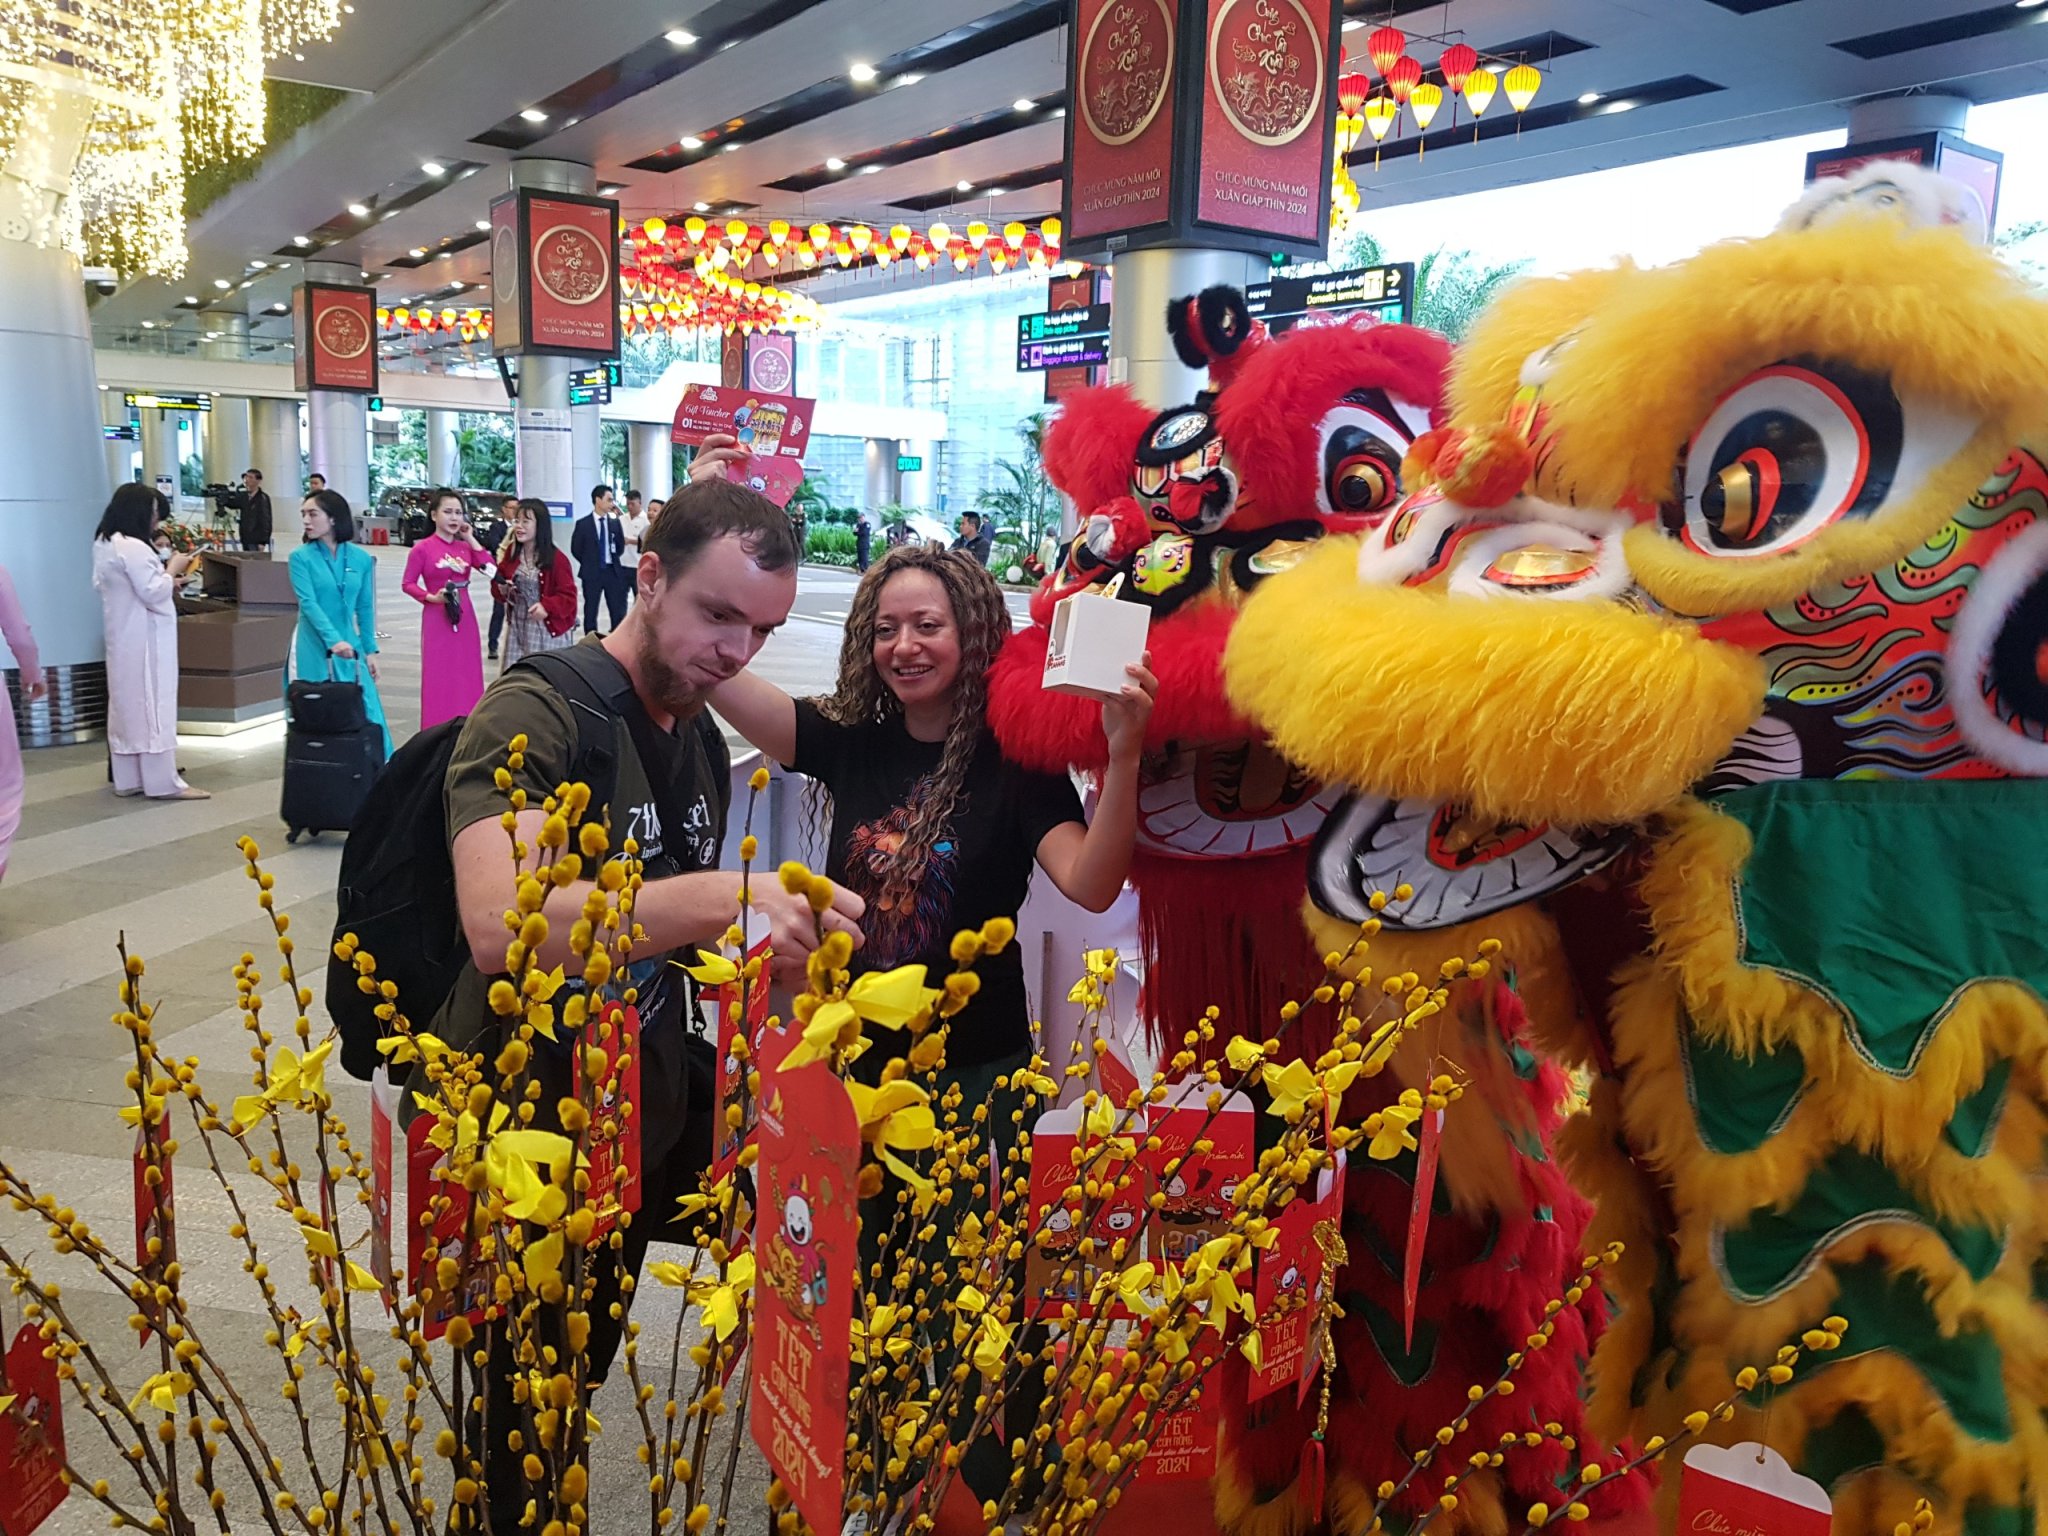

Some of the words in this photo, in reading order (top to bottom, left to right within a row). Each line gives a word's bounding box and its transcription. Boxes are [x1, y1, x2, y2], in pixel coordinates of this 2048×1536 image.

[1128, 171, 1145, 185] NĂM
[1145, 168, 1161, 181] MỚI
[1215, 170, 1241, 185] CHÚC
[1242, 174, 1269, 191] MỪNG
[1270, 180, 1290, 195] NĂM
[1291, 184, 1308, 198] MỚI
[1083, 198, 1104, 212] XUÂN
[1104, 194, 1122, 208] GIÁP
[1141, 186, 1160, 200] 2024
[1215, 188, 1241, 204] XUÂN
[1241, 193, 1263, 207] GIÁP
[1264, 197, 1286, 211] THÌN
[1286, 201, 1308, 215] 2024
[1307, 293, 1337, 305] Domestic
[1043, 356, 1062, 365] Baggage
[1062, 355, 1079, 363] storage
[1084, 351, 1103, 361] delivery
[610, 366, 618, 385] 3
[371, 399, 382, 411] 4
[700, 406, 731, 419] Voucher
[682, 417, 693, 429] 01
[1158, 1133, 1187, 1155] Chúc
[1042, 1163, 1074, 1188] Chúc
[1275, 1315, 1299, 1344] TẾT
[776, 1314, 813, 1394] TẾT
[1269, 1358, 1295, 1387] 2024
[1163, 1412, 1193, 1437] TẾT
[772, 1416, 808, 1500] 2024
[1156, 1455, 1191, 1475] 2024
[1691, 1509, 1732, 1535] Chúc
